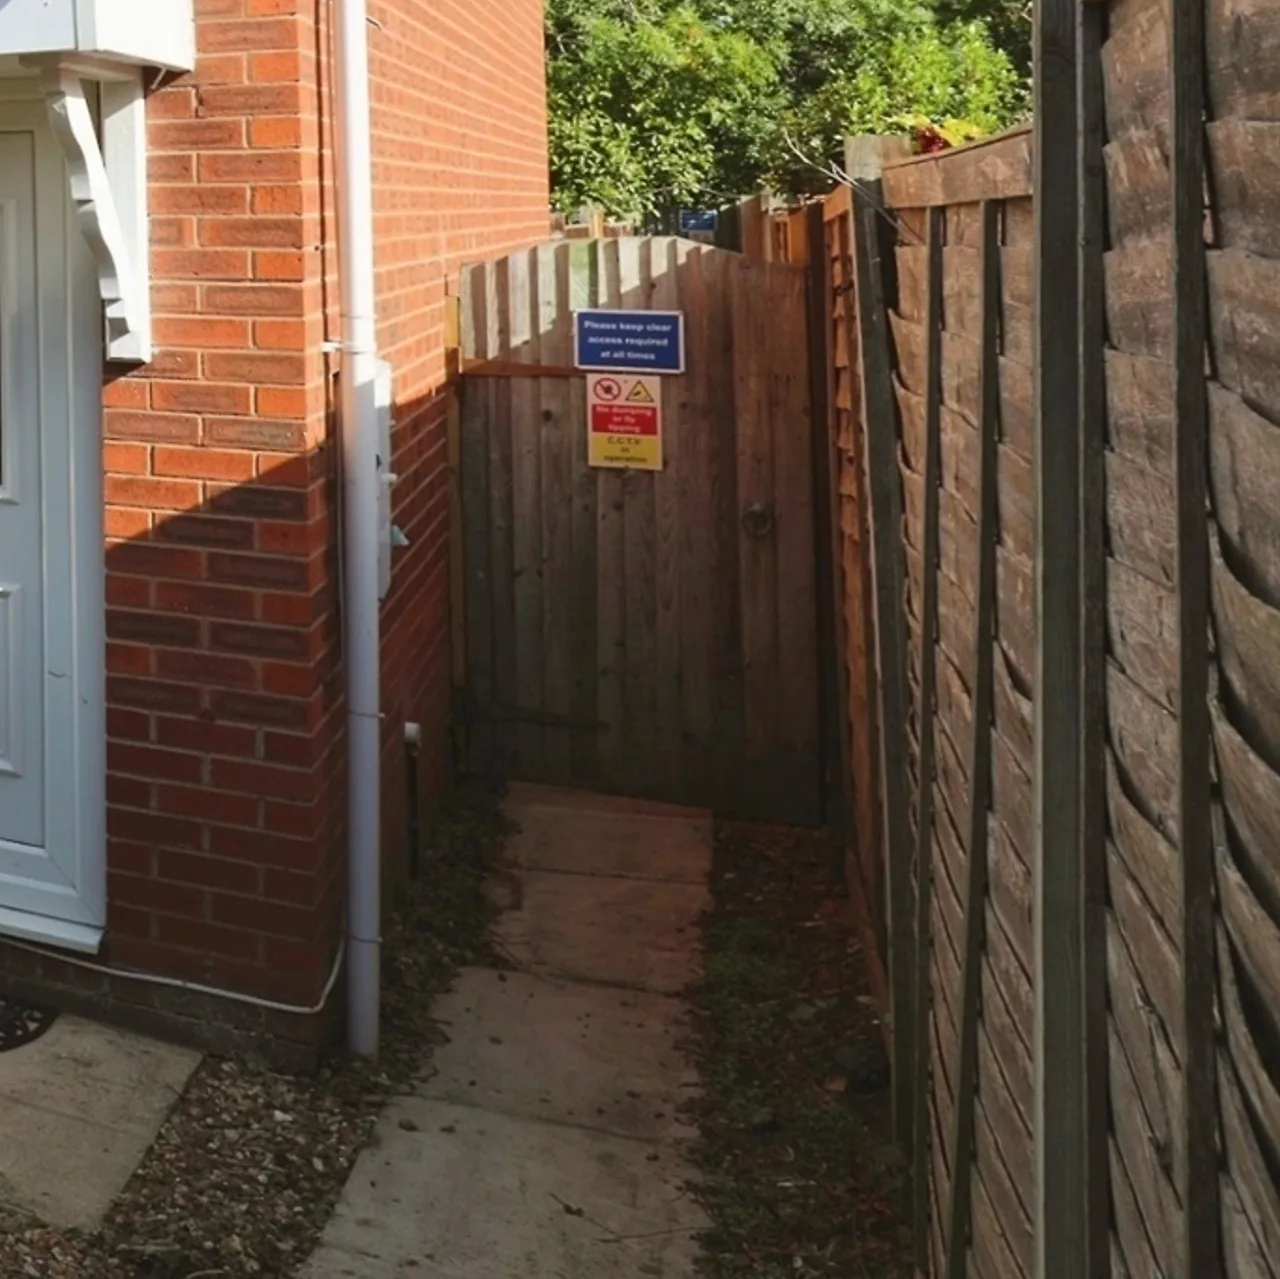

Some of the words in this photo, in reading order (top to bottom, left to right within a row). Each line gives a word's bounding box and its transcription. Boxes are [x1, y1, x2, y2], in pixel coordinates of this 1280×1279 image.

[584, 320, 617, 330] Please
[619, 322, 644, 332] keep
[646, 323, 672, 332] clear
[625, 337, 669, 347] required
